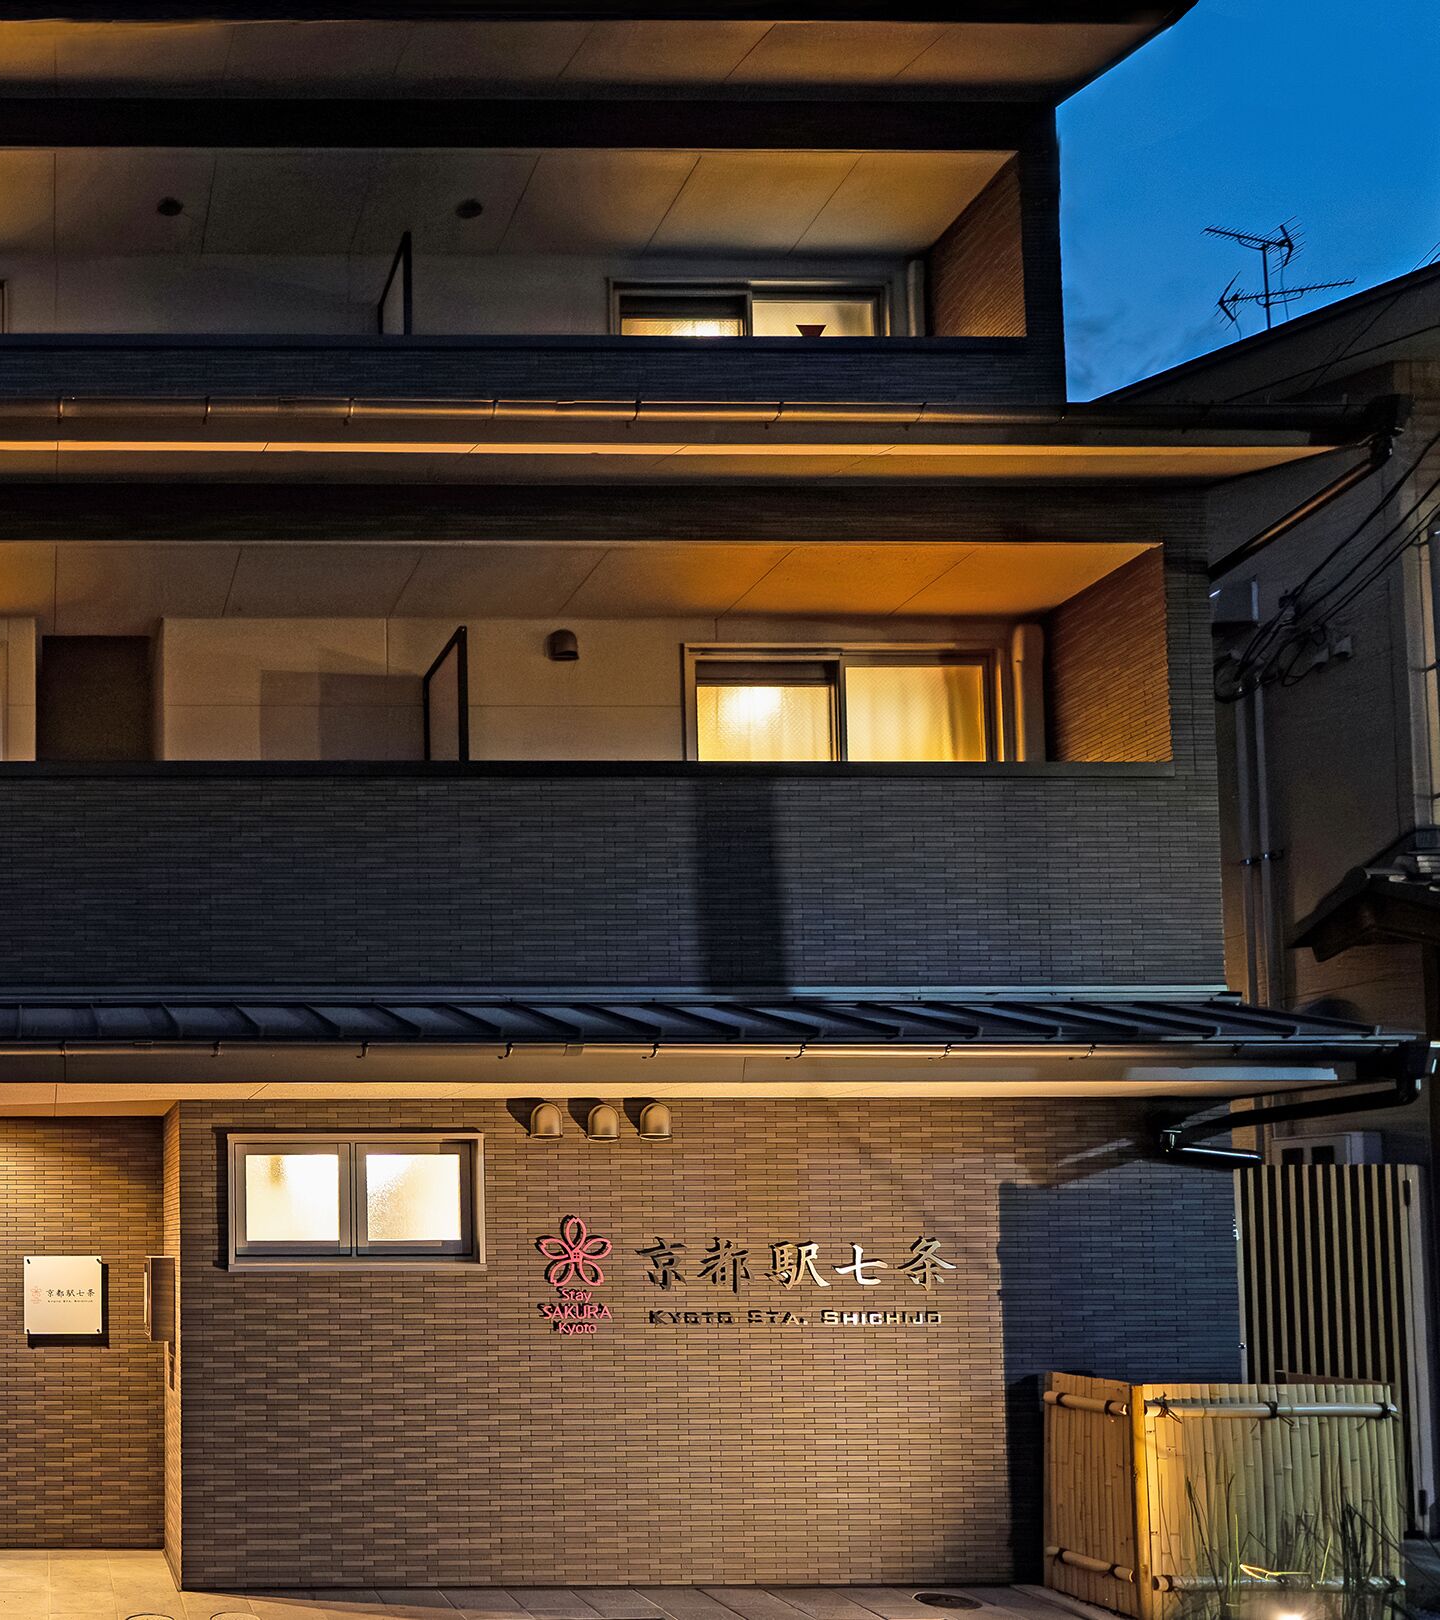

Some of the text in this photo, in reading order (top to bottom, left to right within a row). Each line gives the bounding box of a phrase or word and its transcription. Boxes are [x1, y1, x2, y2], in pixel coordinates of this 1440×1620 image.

[635, 1237, 957, 1294] 京都駅七条
[561, 1288, 592, 1303] Stay
[542, 1305, 613, 1320] SAKURA
[649, 1310, 735, 1325] KYOTO
[821, 1310, 942, 1326] SHICHIJO
[558, 1322, 598, 1336] Kyoto
